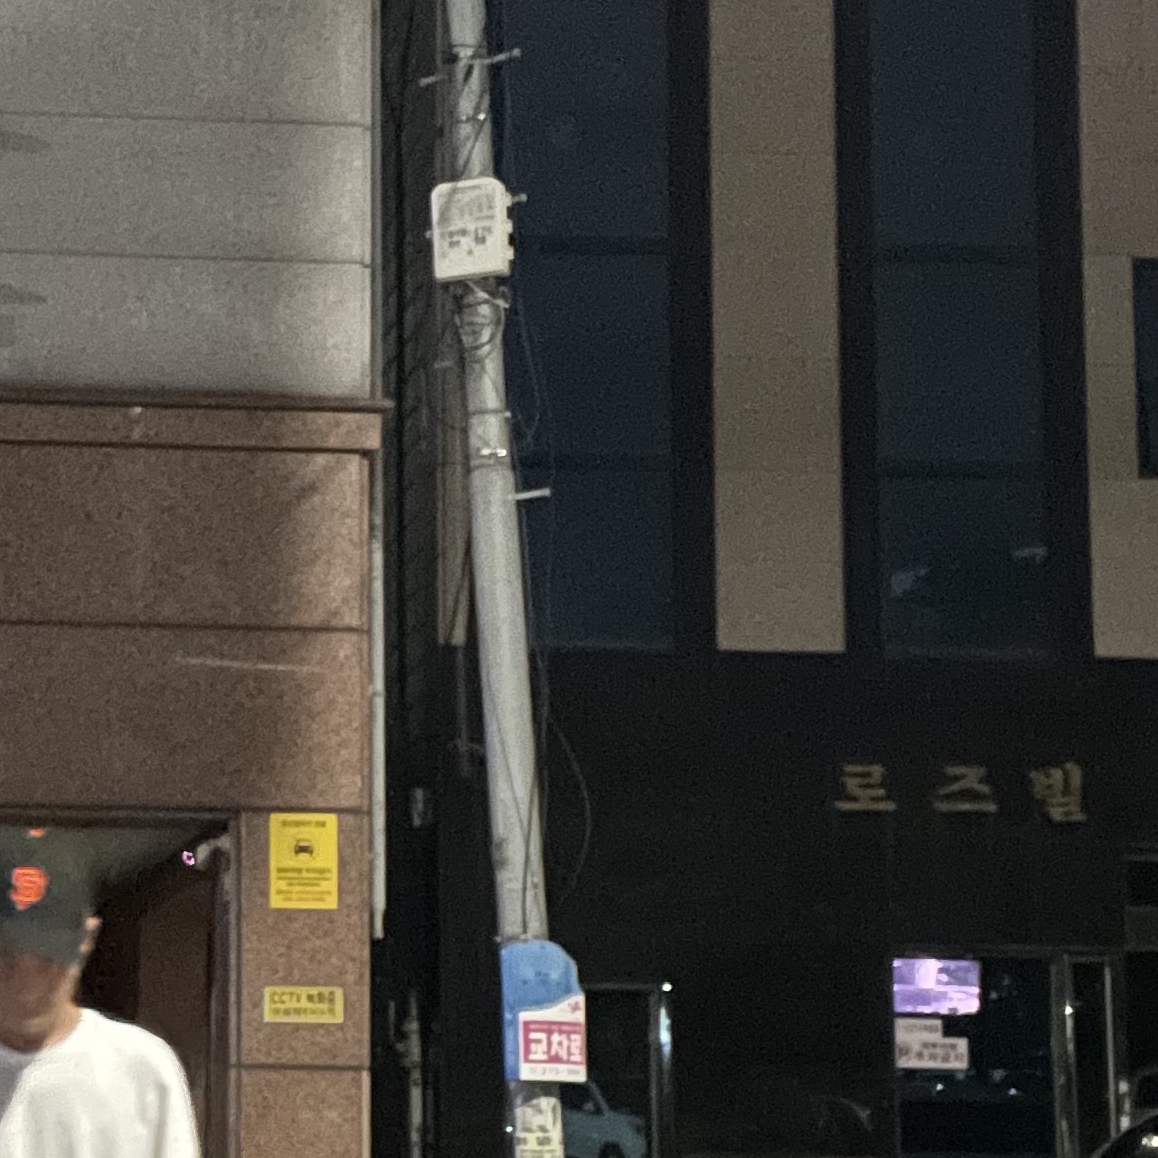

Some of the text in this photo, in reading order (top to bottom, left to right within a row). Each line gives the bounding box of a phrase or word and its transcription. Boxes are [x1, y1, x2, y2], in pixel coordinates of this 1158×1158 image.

[835, 761, 1088, 823] 로즈빌
[271, 991, 301, 1004] CCTV
[528, 1031, 582, 1062] 교차로
